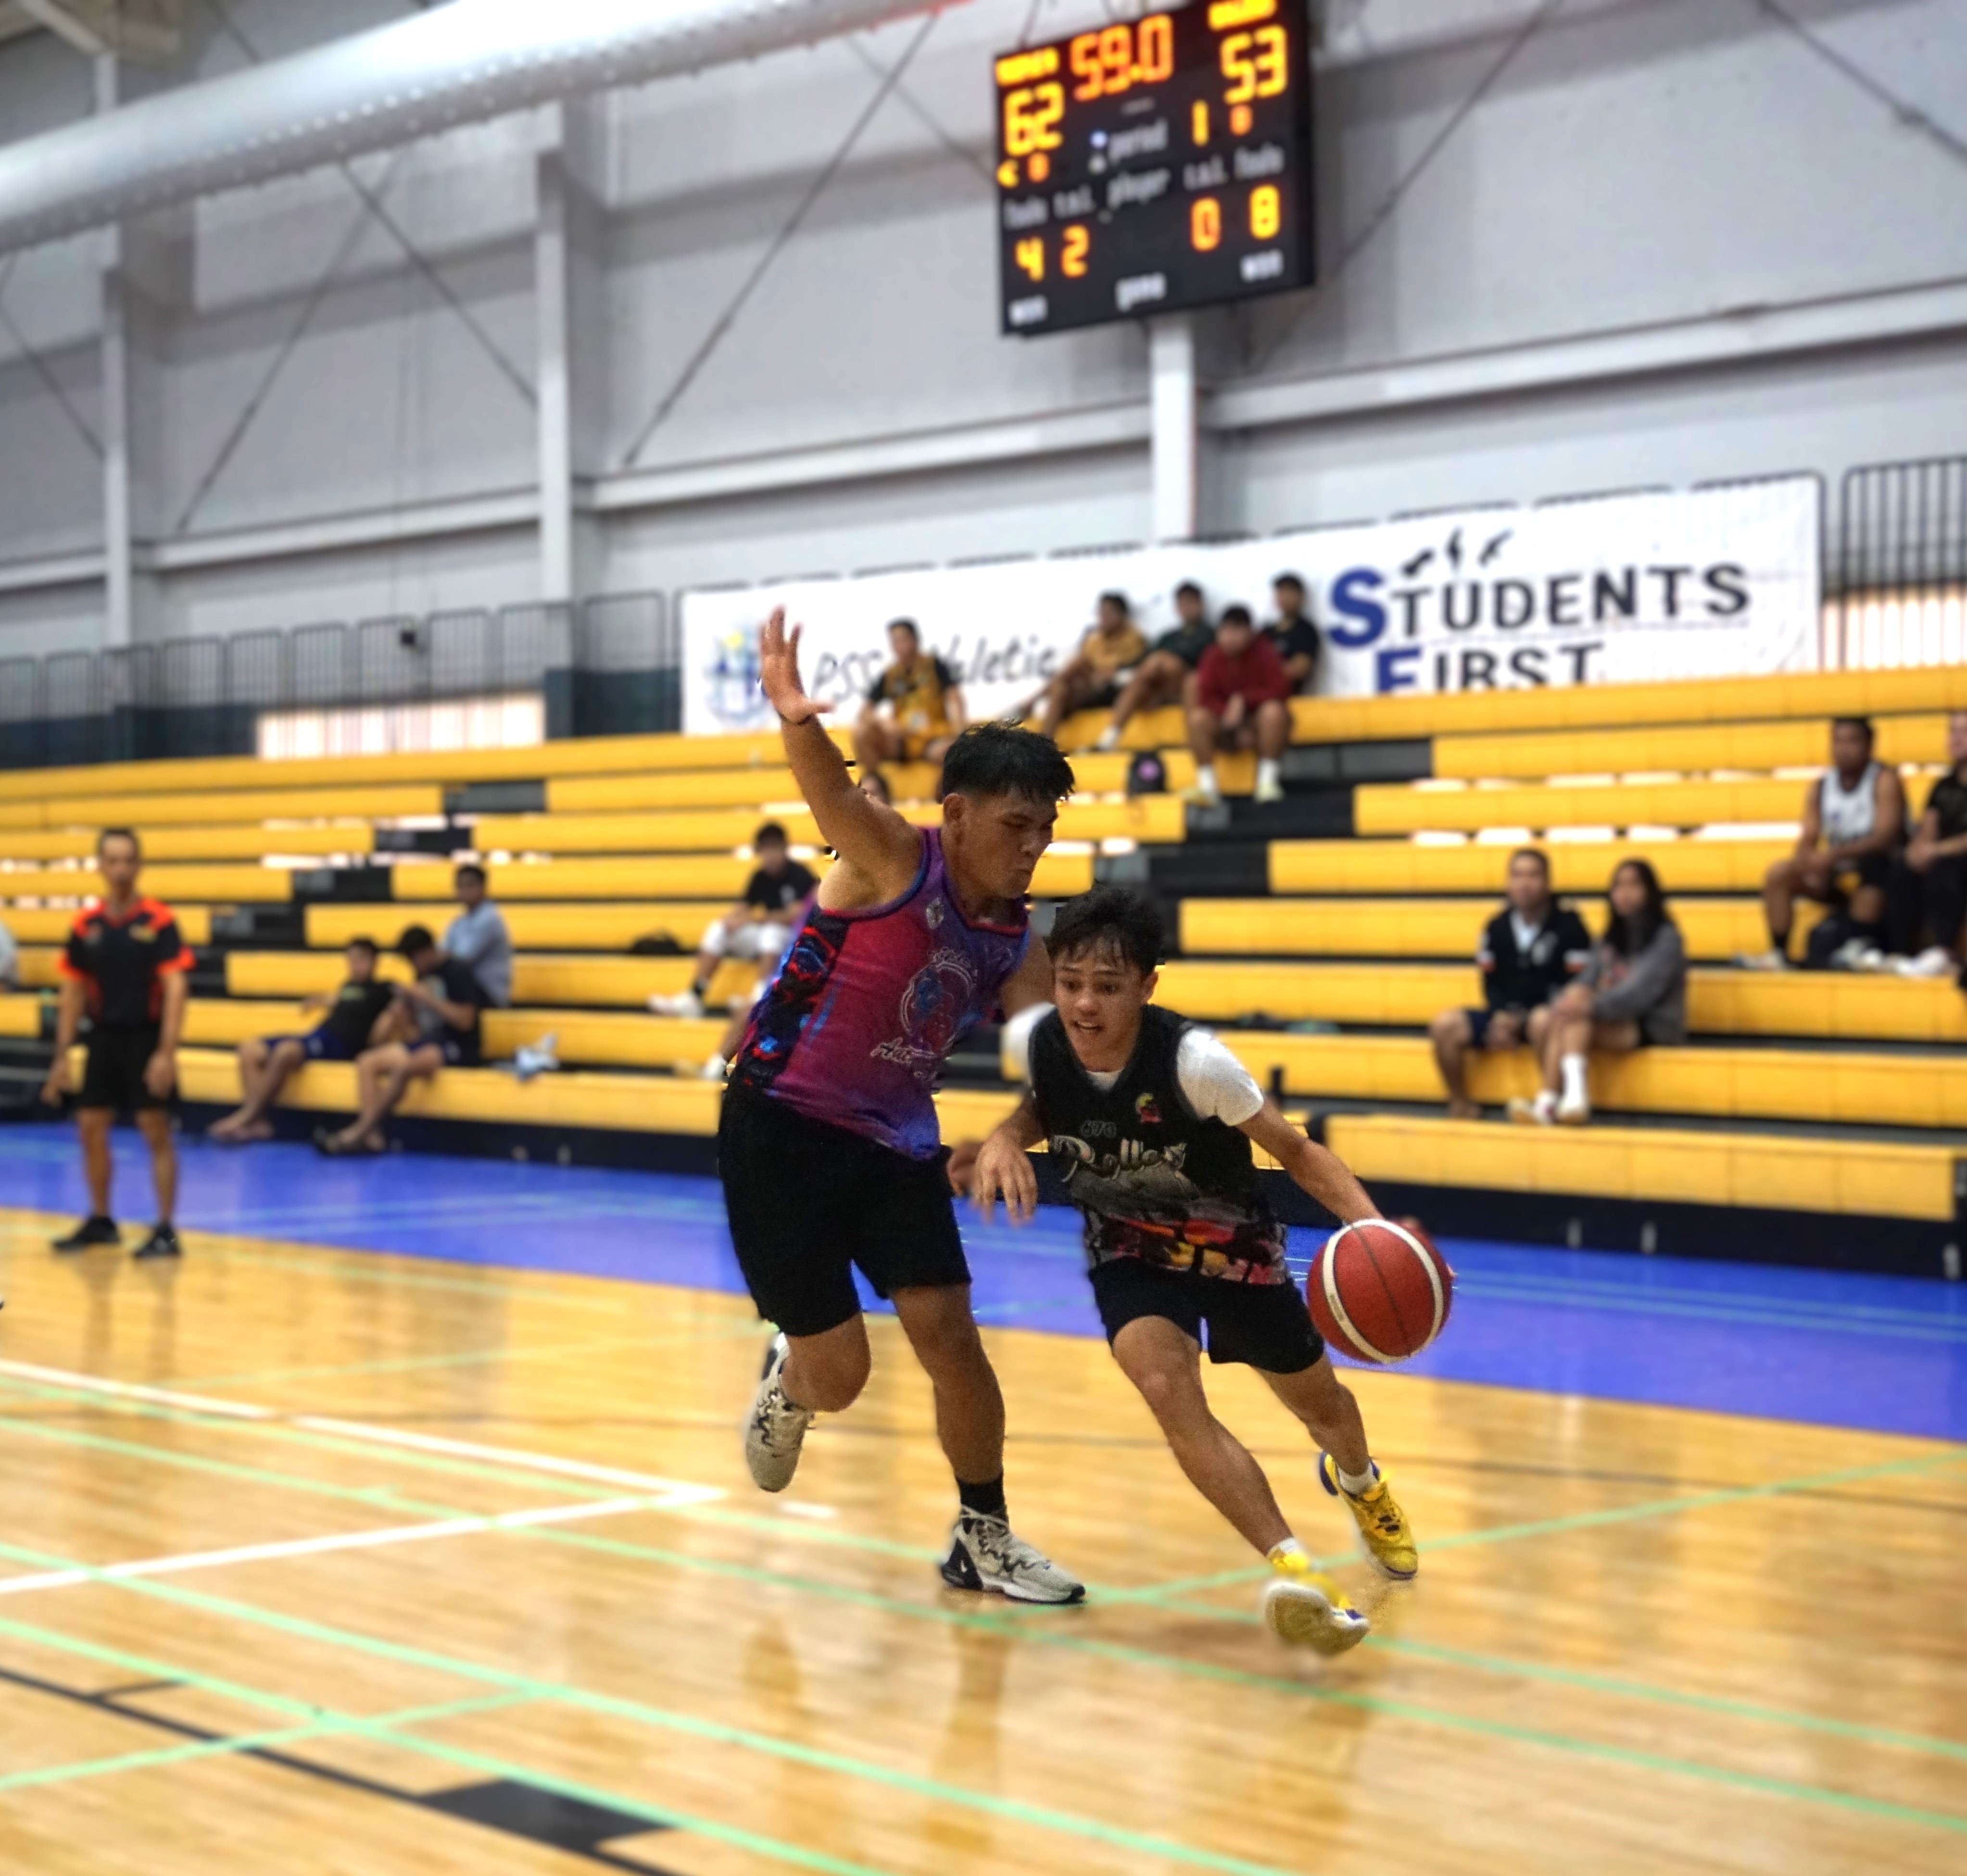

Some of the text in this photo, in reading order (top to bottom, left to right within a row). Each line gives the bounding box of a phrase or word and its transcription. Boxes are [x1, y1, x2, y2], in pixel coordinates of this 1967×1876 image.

[1071, 13, 1173, 101] 59.0
[1221, 25, 1287, 104] 53
[1004, 81, 1064, 156] 62
[1192, 99, 1209, 147] 1
[1015, 225, 1090, 282] 4 2
[1191, 185, 1280, 252] 0 8
[1328, 563, 1751, 647] STUDENTS
[1374, 642, 1604, 697] FIRST
